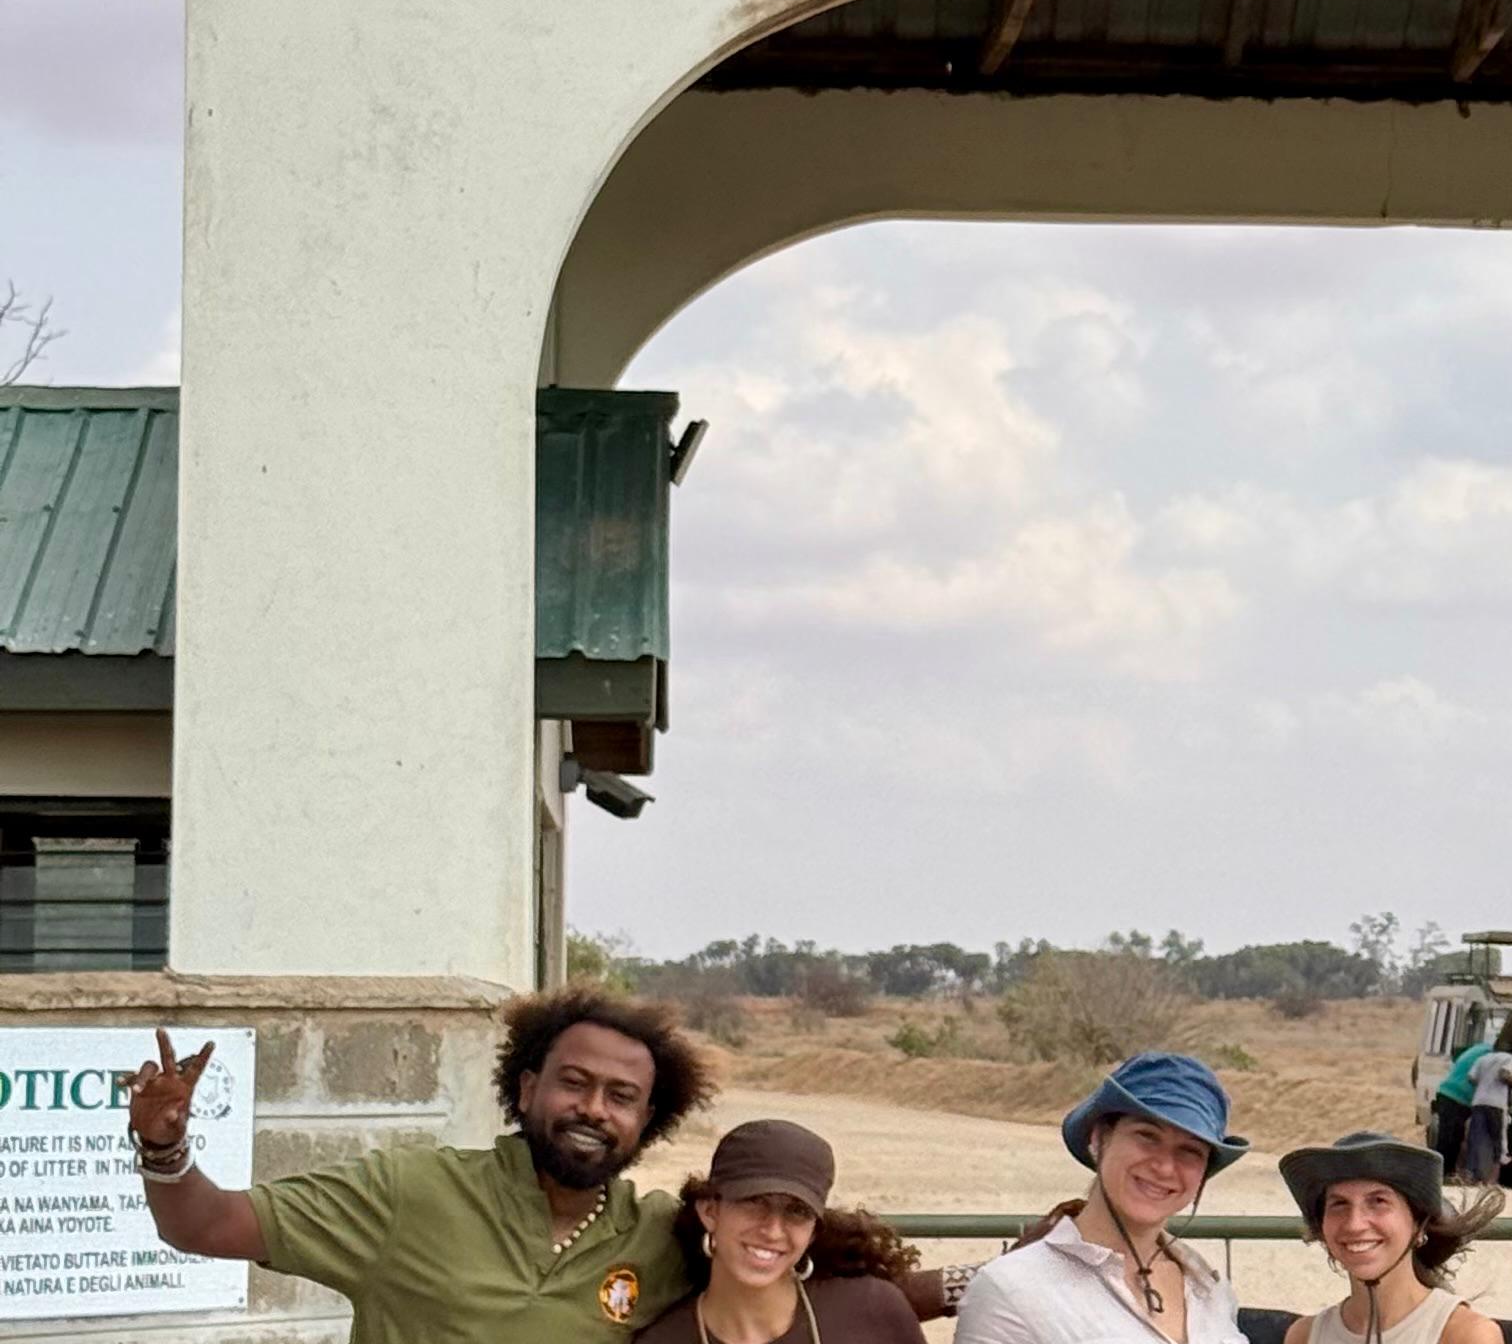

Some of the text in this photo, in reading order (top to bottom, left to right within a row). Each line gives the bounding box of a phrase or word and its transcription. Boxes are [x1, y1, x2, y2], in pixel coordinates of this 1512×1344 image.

[0, 1135, 49, 1153] ATURE
[52, 1135, 65, 1152] IT
[68, 1135, 82, 1153] IS
[85, 1134, 115, 1152] NOT
[9, 1159, 29, 1178] OF
[33, 1158, 87, 1177] LITTER
[95, 1158, 110, 1176] IN
[14, 1196, 35, 1213] NA
[19, 1216, 54, 1234] AINA
[63, 1249, 128, 1270] BUTTARE
[4, 1276, 63, 1297] NATURA
[66, 1276, 76, 1295] E
[79, 1273, 122, 1293] DEGLI
